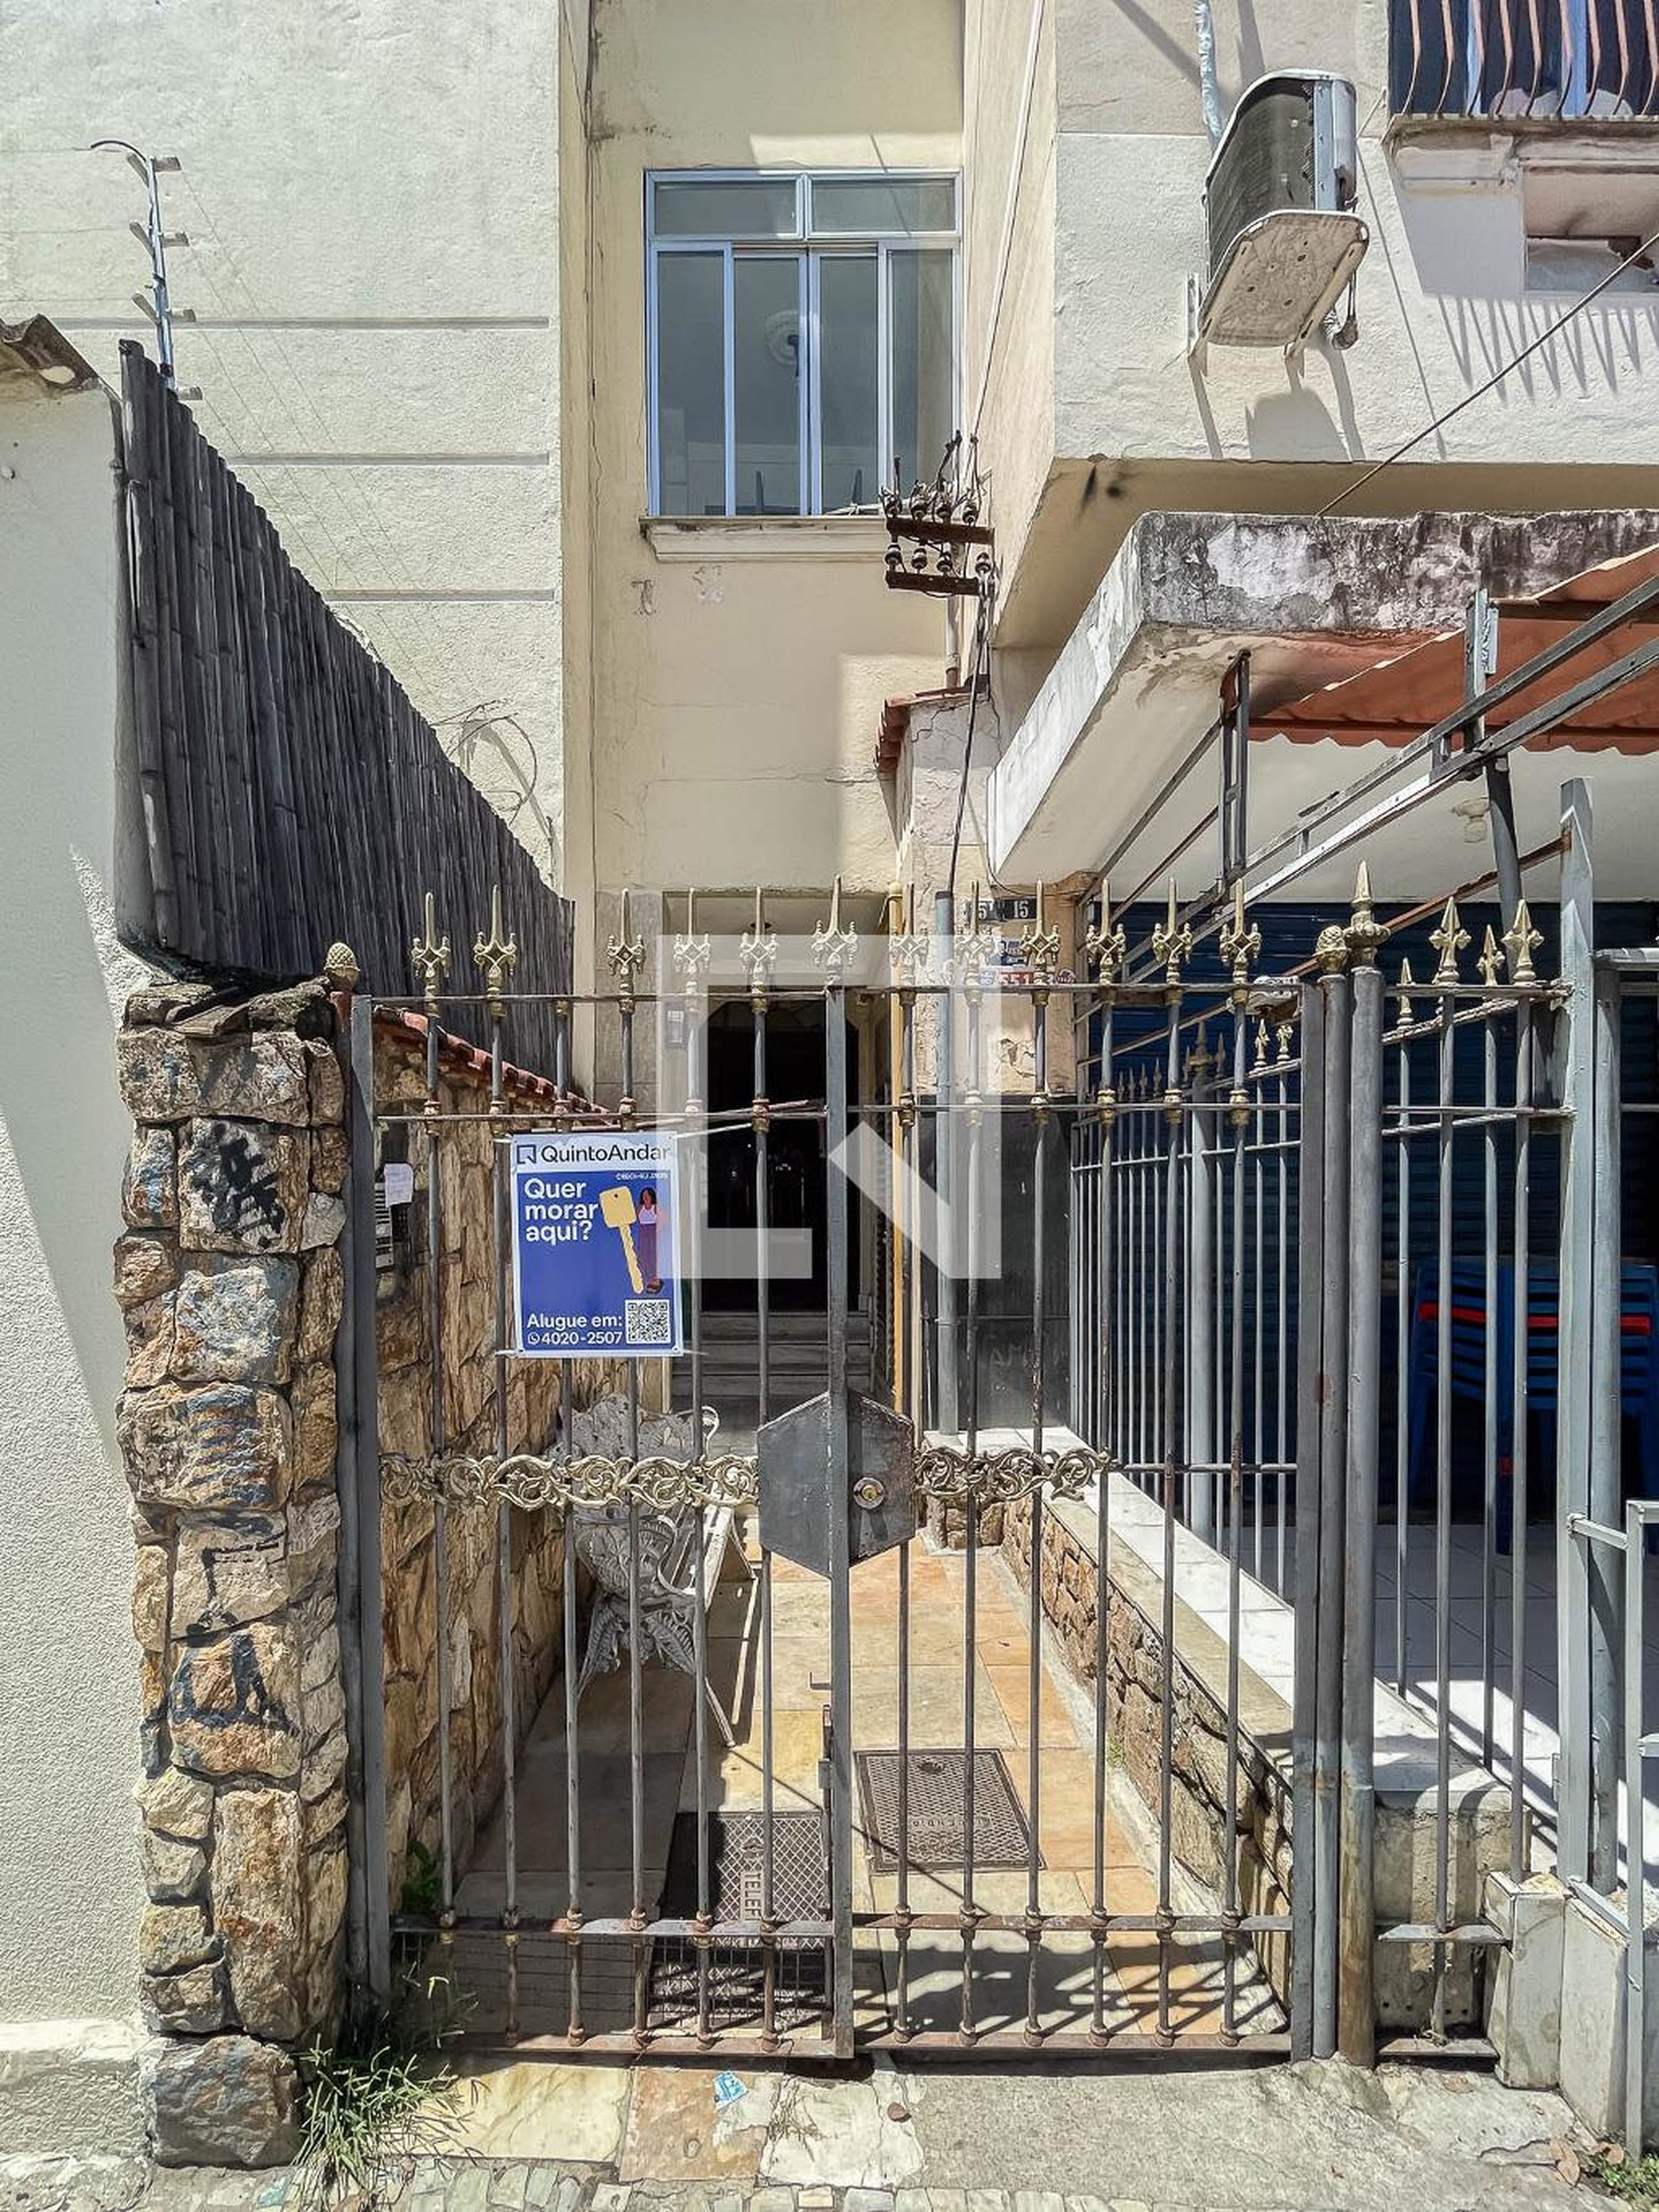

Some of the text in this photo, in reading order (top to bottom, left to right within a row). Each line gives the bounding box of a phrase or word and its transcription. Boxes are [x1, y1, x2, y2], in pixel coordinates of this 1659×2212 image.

[1014, 901, 1029, 918] 15
[541, 1144, 669, 1162] QuintoAndar
[524, 1178, 587, 1199] Quer
[524, 1203, 598, 1220] morar
[525, 1220, 593, 1245] aqui?
[527, 1313, 623, 1331] Alugue em:
[541, 1331, 623, 1345] 4020-2507
